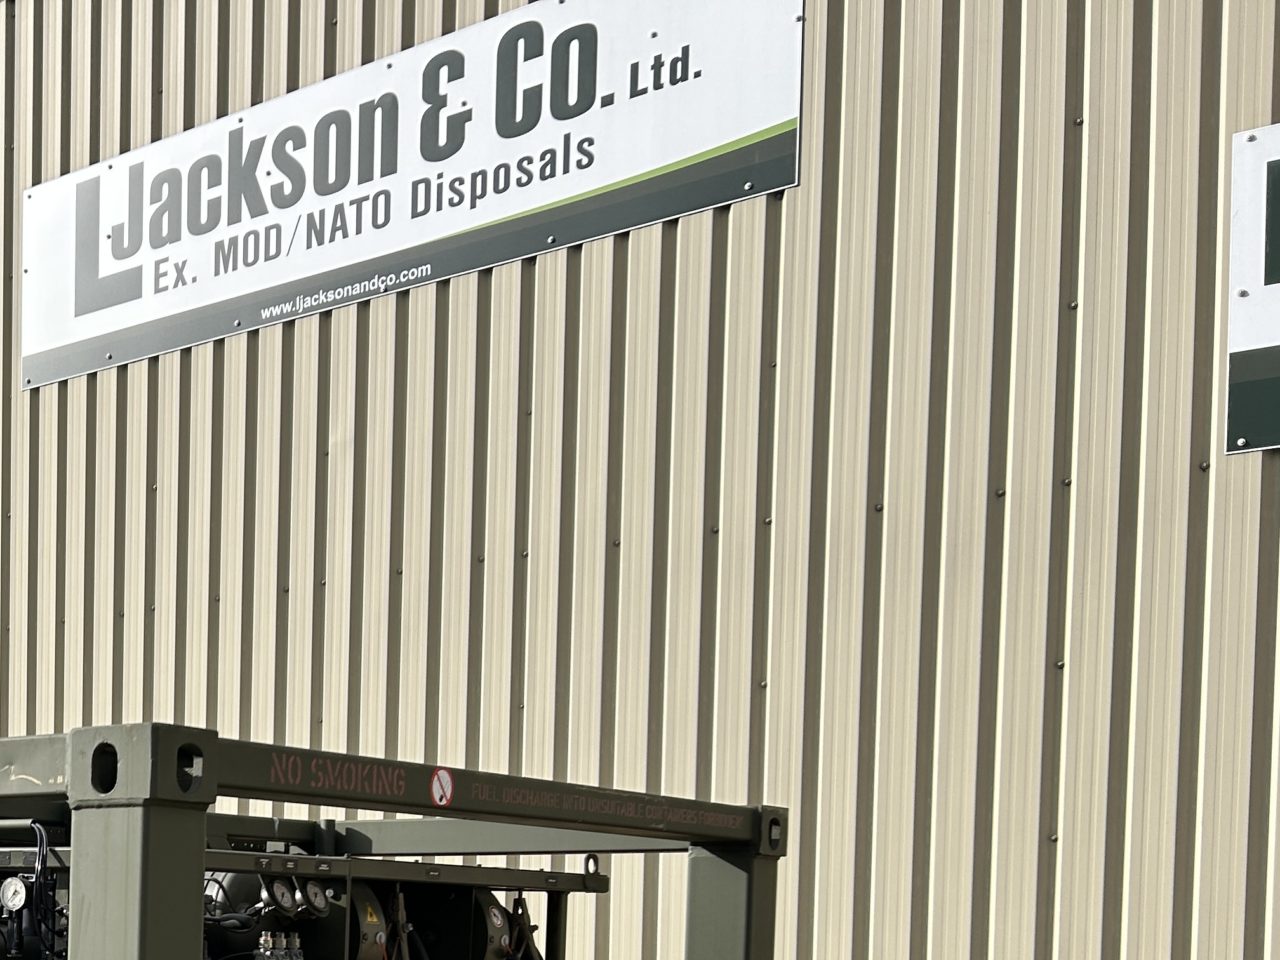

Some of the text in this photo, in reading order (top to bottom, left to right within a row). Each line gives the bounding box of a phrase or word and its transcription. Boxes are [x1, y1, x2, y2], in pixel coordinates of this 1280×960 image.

[419, 49, 473, 163] &
[495, 20, 615, 139] Co.
[629, 44, 702, 99] Ltd.
[153, 132, 595, 295] Ex. MOD/NATO Disposals
[260, 262, 432, 320] www.ljacksonandco.com
[271, 752, 406, 796] NO SMOKING
[472, 783, 497, 803] FUEL
[502, 787, 561, 809] DISCHARGE
